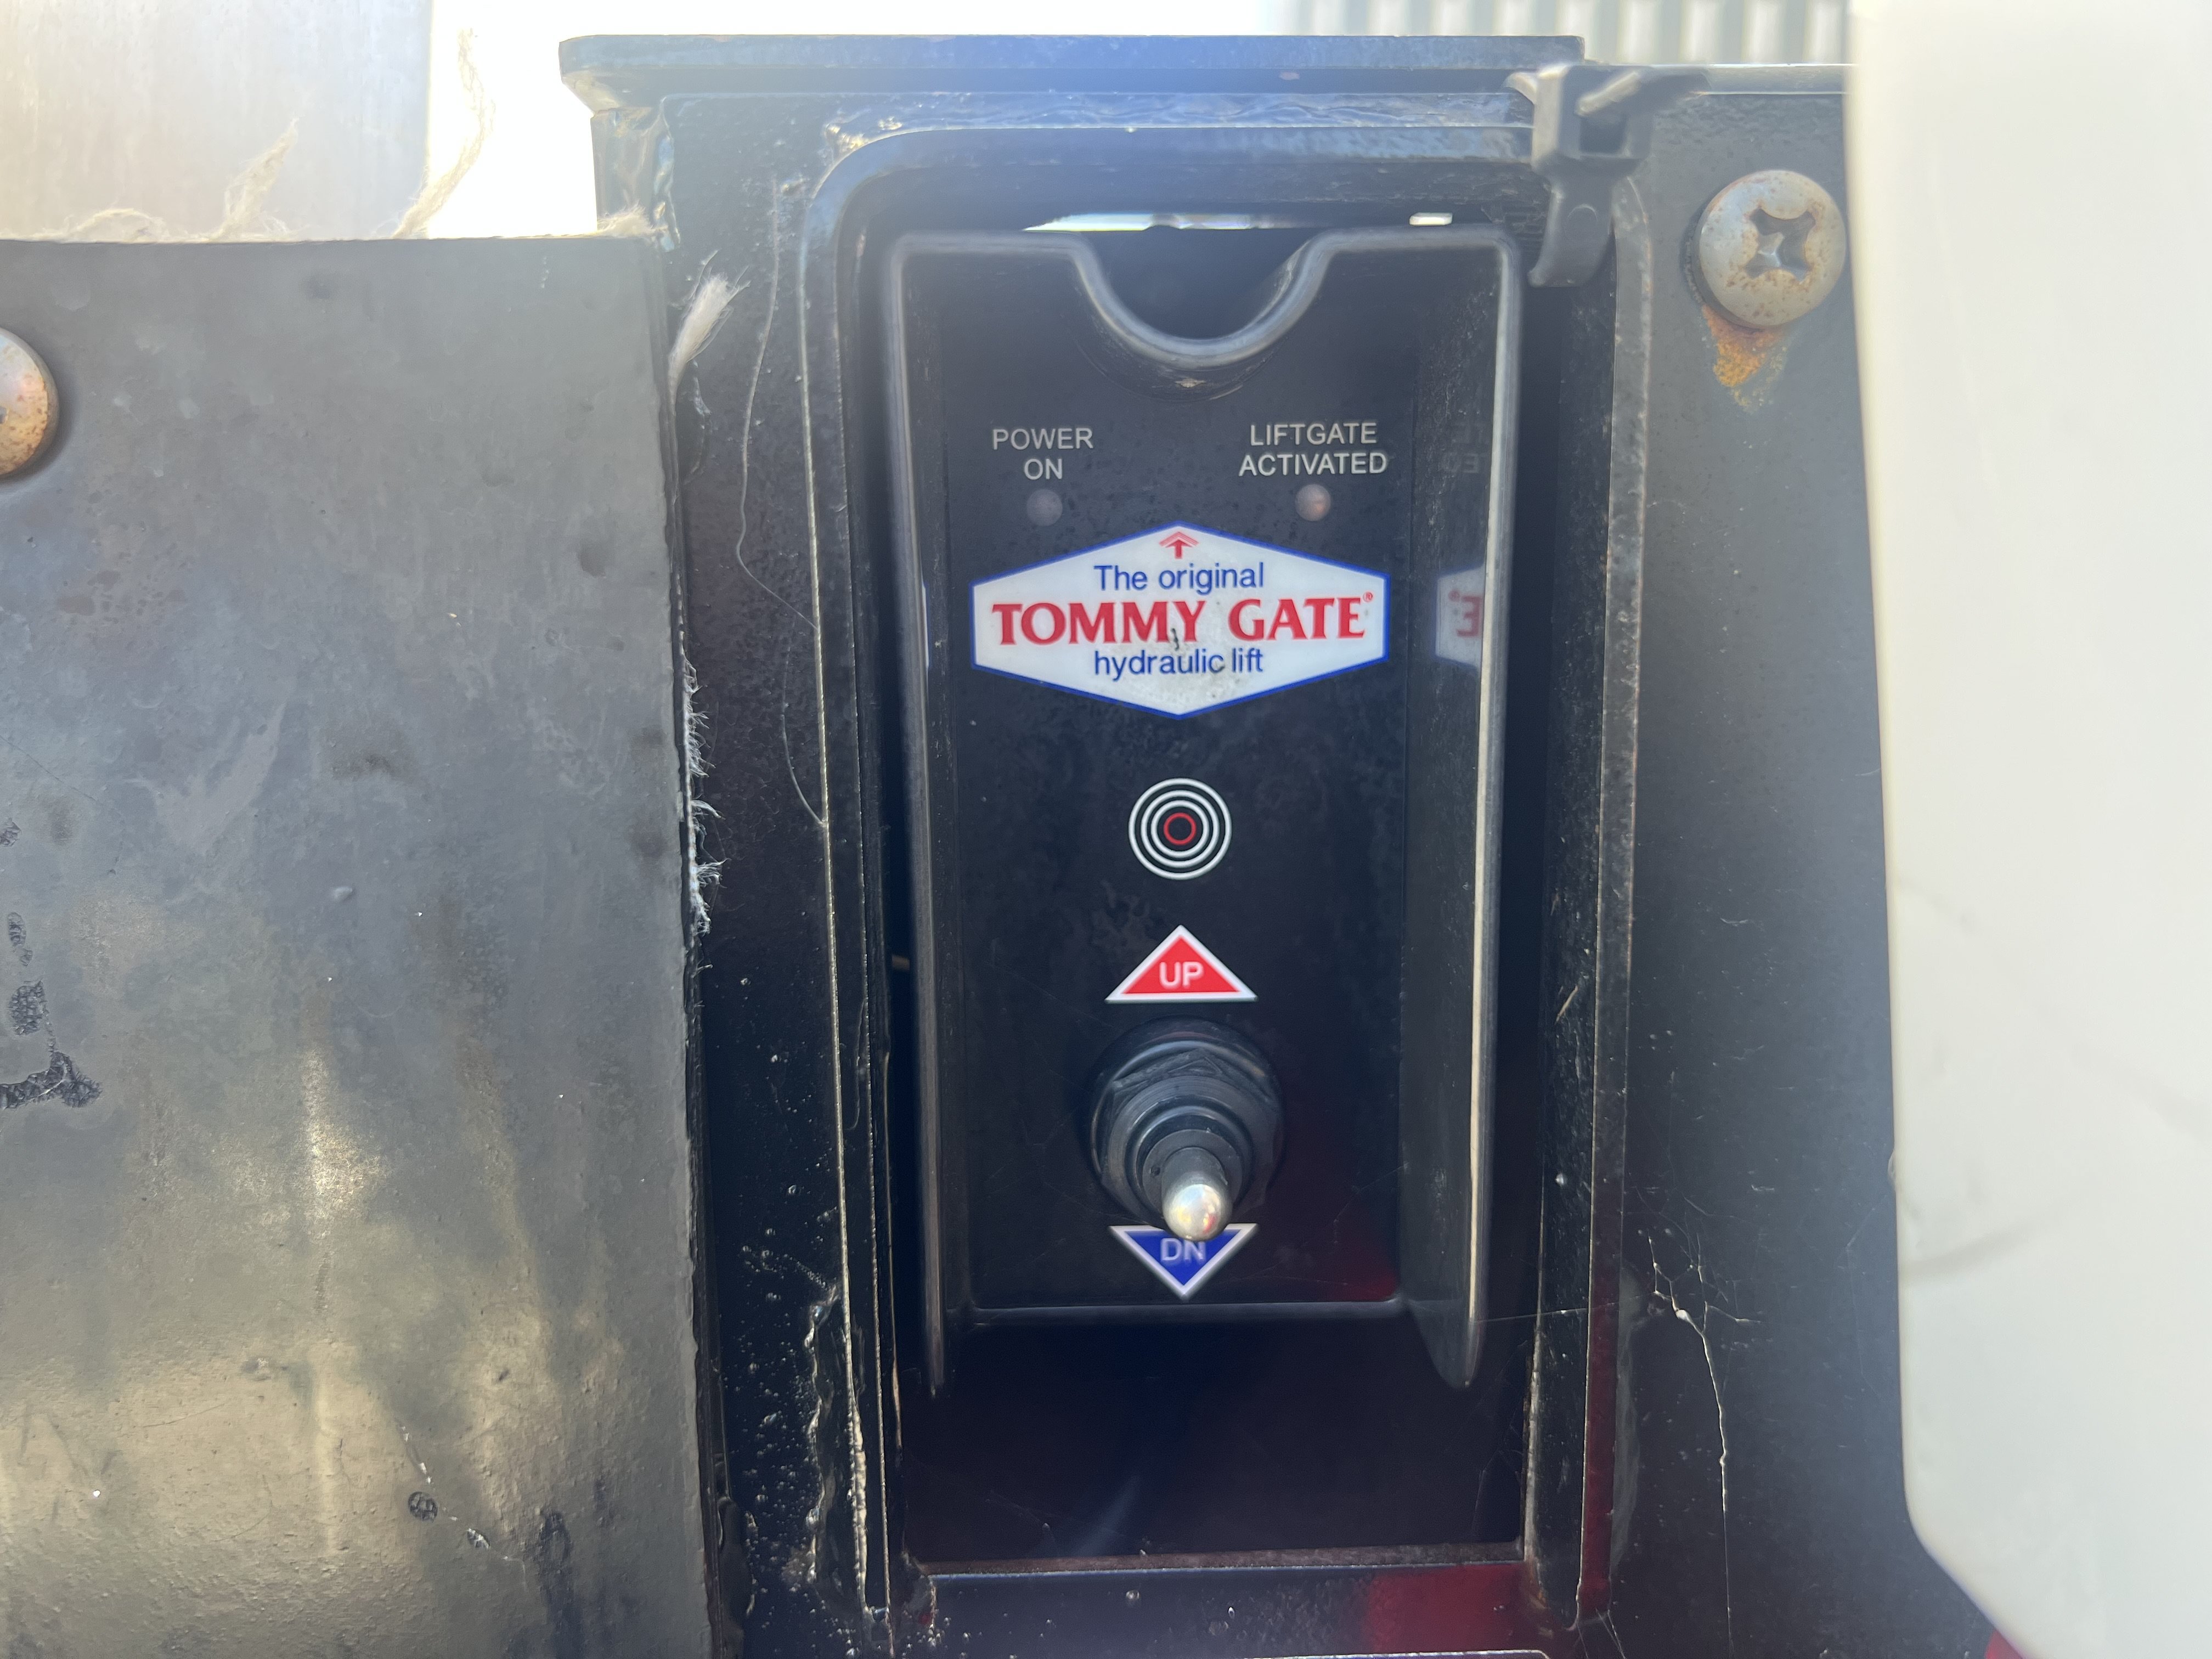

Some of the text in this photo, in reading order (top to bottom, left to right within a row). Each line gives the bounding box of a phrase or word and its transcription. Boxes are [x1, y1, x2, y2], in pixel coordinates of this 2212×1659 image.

[992, 427, 1094, 450] POWER
[1250, 422, 1378, 446] LIFTGATE
[1024, 458, 1063, 479] ON
[1239, 453, 1388, 477] ACTIVATED
[1093, 562, 1264, 595] The original
[991, 600, 1207, 645] TOMMY
[1094, 648, 1263, 681] hydraulic lift
[1159, 961, 1204, 988] UP
[1160, 1237, 1205, 1262] DN
